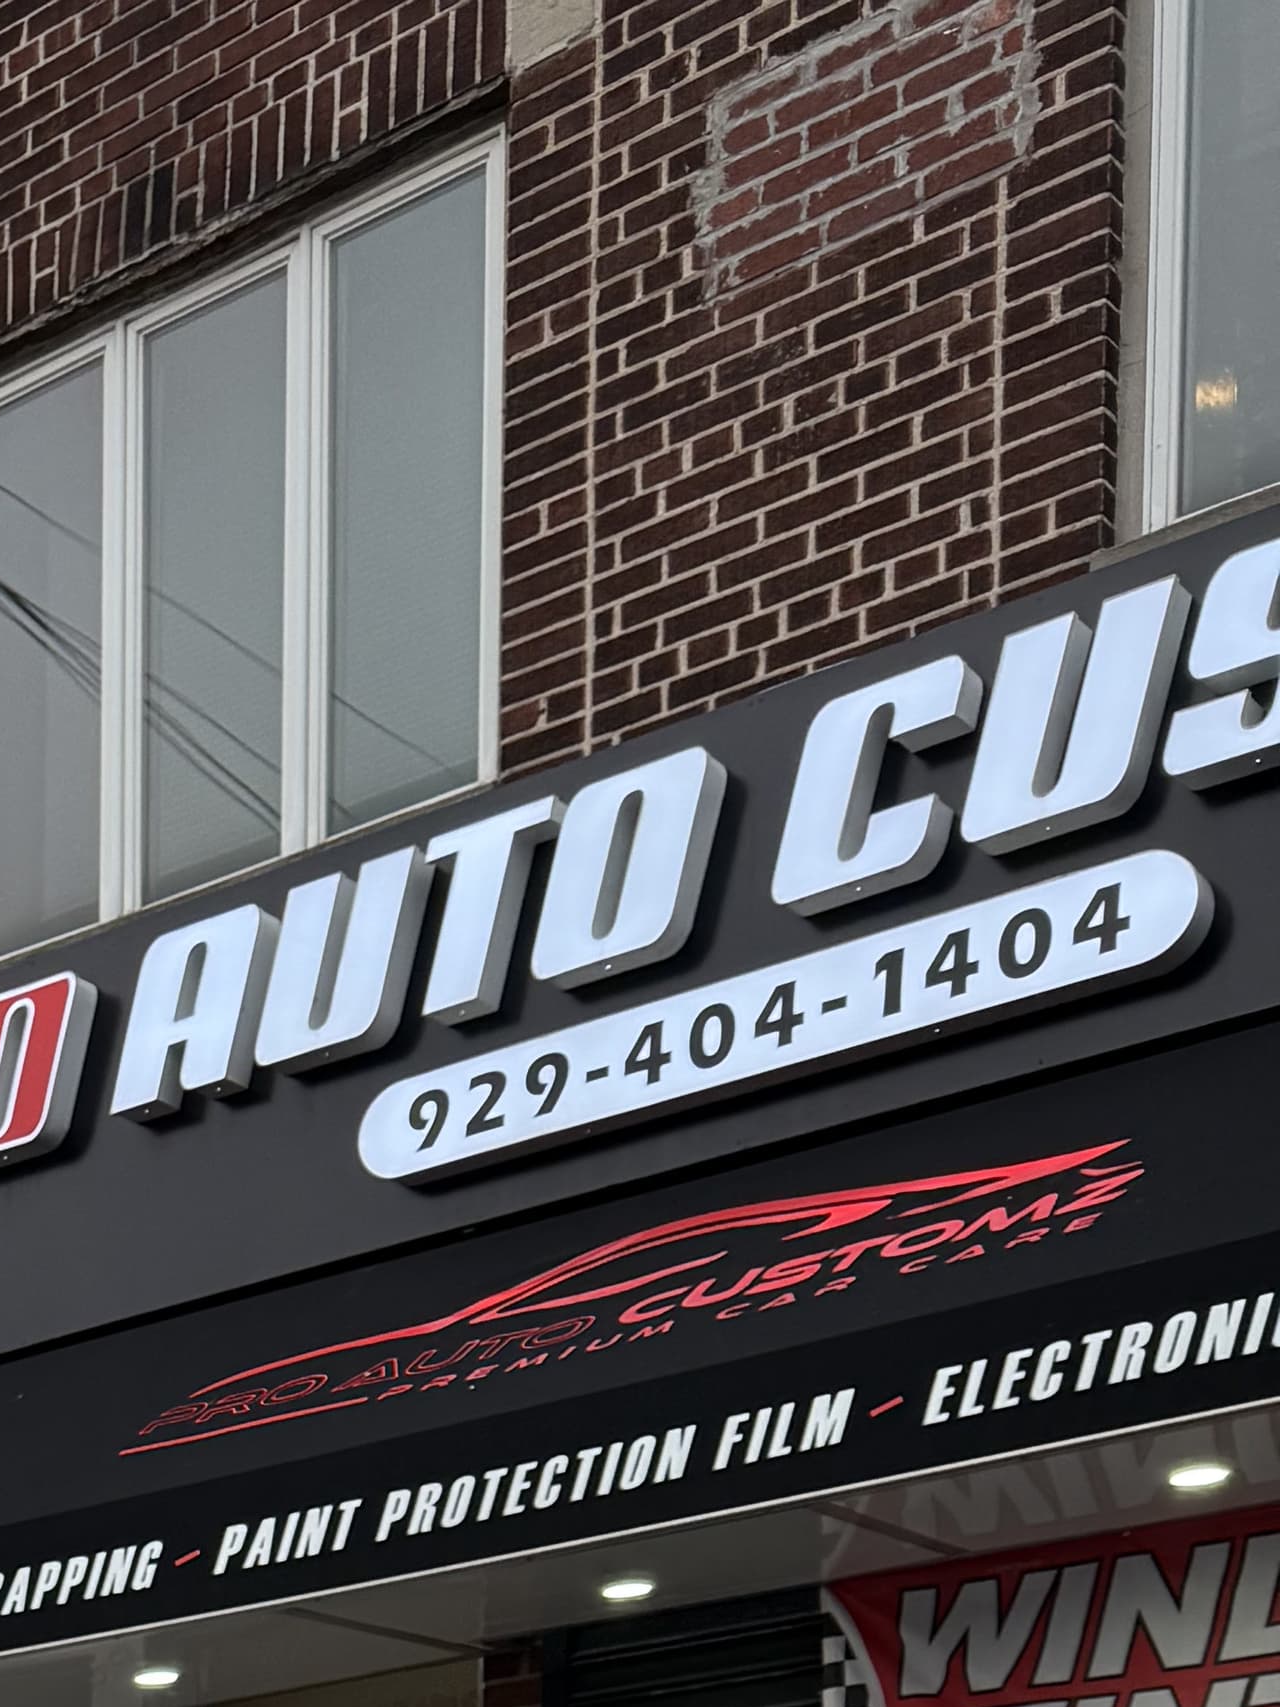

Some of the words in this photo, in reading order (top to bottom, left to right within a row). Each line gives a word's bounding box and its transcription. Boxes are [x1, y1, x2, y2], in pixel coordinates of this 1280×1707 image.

[110, 745, 720, 1119] AUTO
[406, 884, 1133, 1152] 929-404-1404
[138, 1374, 329, 1435] PRO
[331, 1315, 596, 1393] AUTO
[618, 1161, 1145, 1324] CUSTOMZ
[213, 1499, 362, 1576] PAINT
[376, 1434, 697, 1542] PROTECTION
[712, 1388, 855, 1473] FILM
[922, 1291, 1280, 1427] ELECTRONI
[377, 1320, 674, 1400] PREMIUM
[716, 1276, 857, 1321] CAR
[899, 1212, 1102, 1275] CARE
